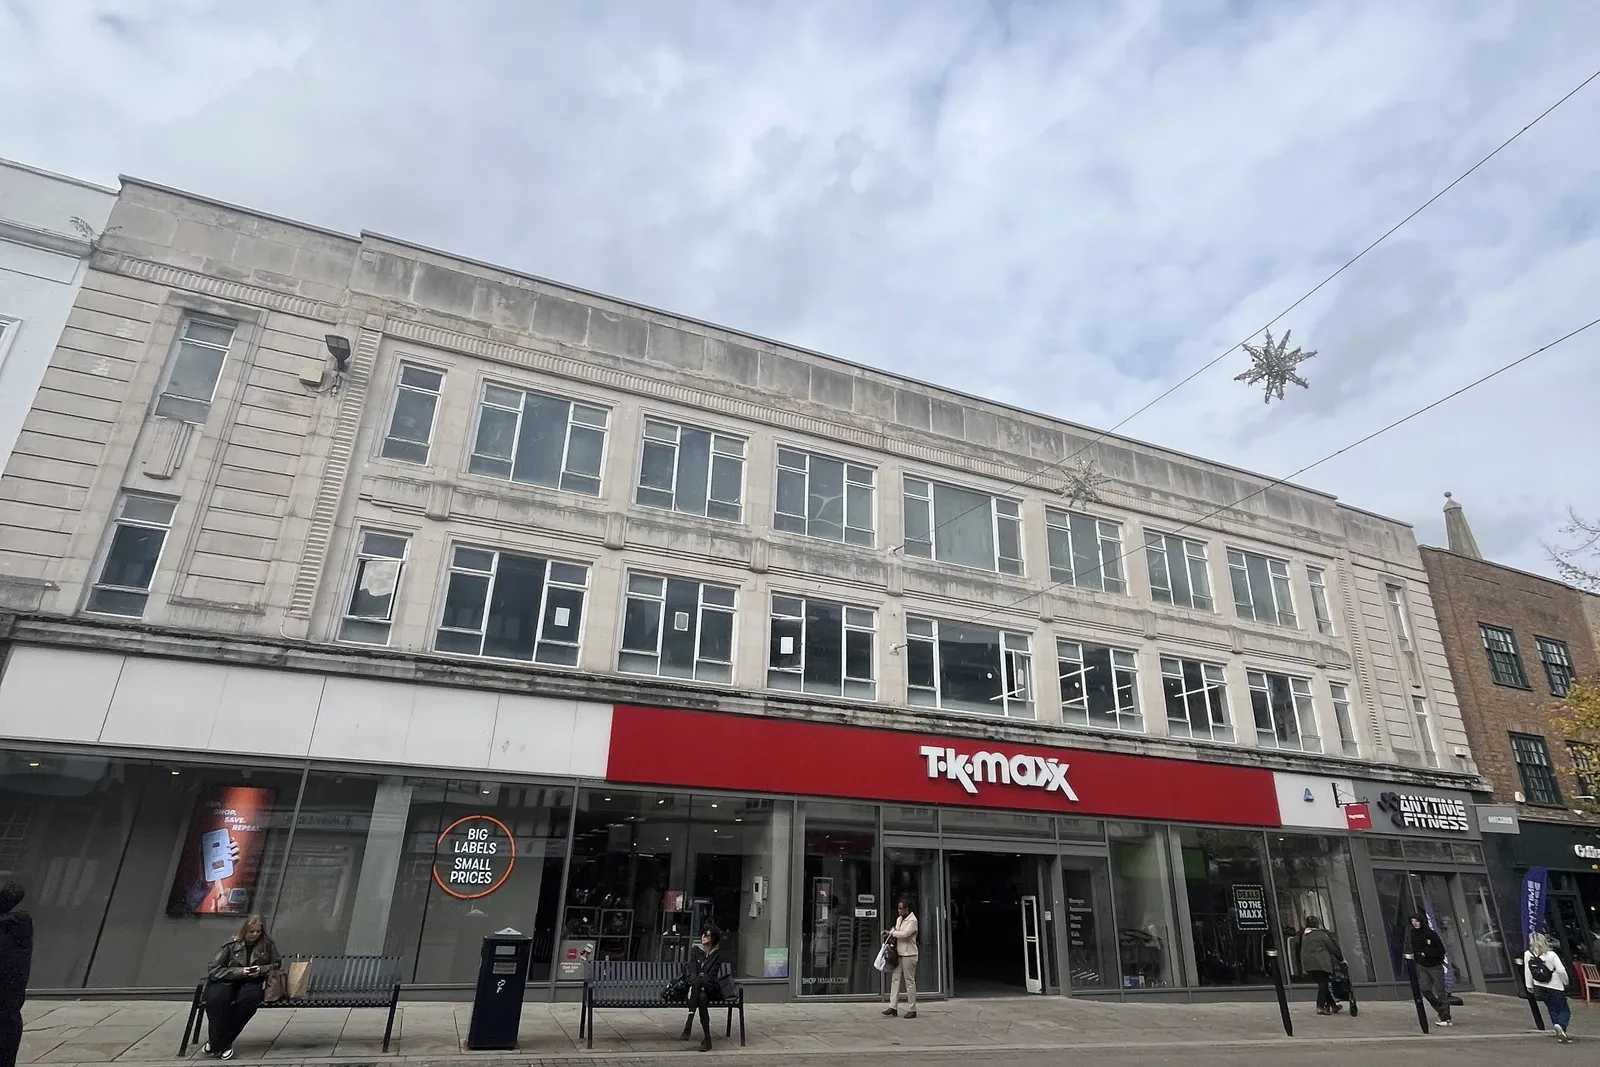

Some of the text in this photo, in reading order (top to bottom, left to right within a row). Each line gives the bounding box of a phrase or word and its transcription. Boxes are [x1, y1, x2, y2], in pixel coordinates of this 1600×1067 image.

[1400, 794, 1467, 817] ANYTIME
[1403, 812, 1470, 831] FITNESS
[468, 828, 488, 840] BIG
[454, 841, 497, 854] LABELS
[454, 857, 491, 871] SMALL
[449, 870, 492, 884] PRICES
[1237, 890, 1260, 899] DEALS
[1237, 900, 1262, 909] TO THE
[1239, 909, 1263, 918] MAXX
